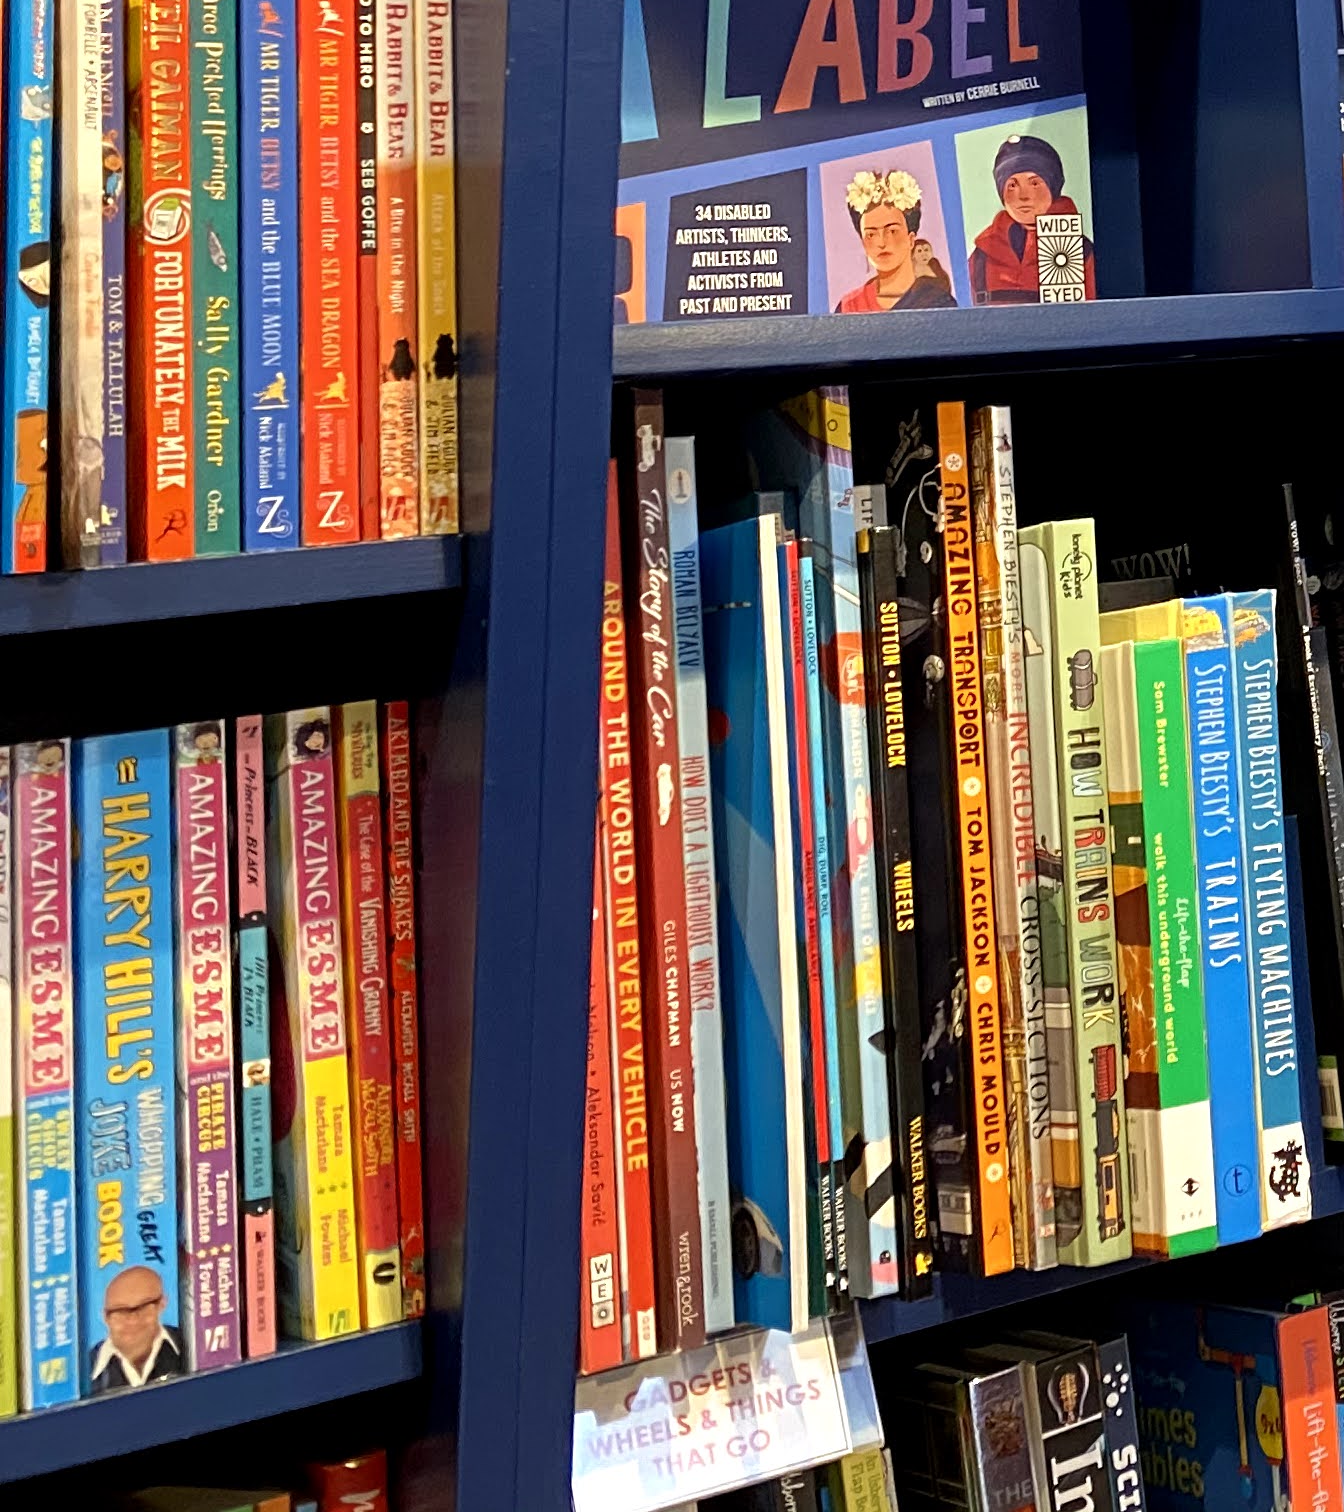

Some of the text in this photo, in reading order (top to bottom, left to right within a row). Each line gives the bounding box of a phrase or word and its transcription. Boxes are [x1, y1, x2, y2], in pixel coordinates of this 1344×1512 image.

[359, 14, 372, 36] TO
[359, 43, 373, 88] HERO
[150, 59, 185, 182] GAIMAN
[674, 225, 792, 247] ARTISTS, THINKERS,
[695, 202, 772, 223] 34 DISABLED
[162, 410, 180, 432] THE
[156, 437, 186, 490] MILK
[878, 601, 915, 934] SUTTON LOVELOCK WHEELS
[601, 579, 650, 1174] AROUND THE WORLD IN EVERY VEHICLE
[1065, 726, 1116, 1032] HOW TRAINS WORK
[1243, 657, 1296, 1078] STEPHEN BIESTY'S FLYING MACHINES
[29, 787, 64, 1086] AMAZING ESME
[101, 792, 154, 1084] HARRY HILL'S
[585, 1378, 822, 1459] WHEELS & THINGS
[623, 1363, 751, 1413] GADGETS
[651, 1429, 771, 1476] THAT GO
